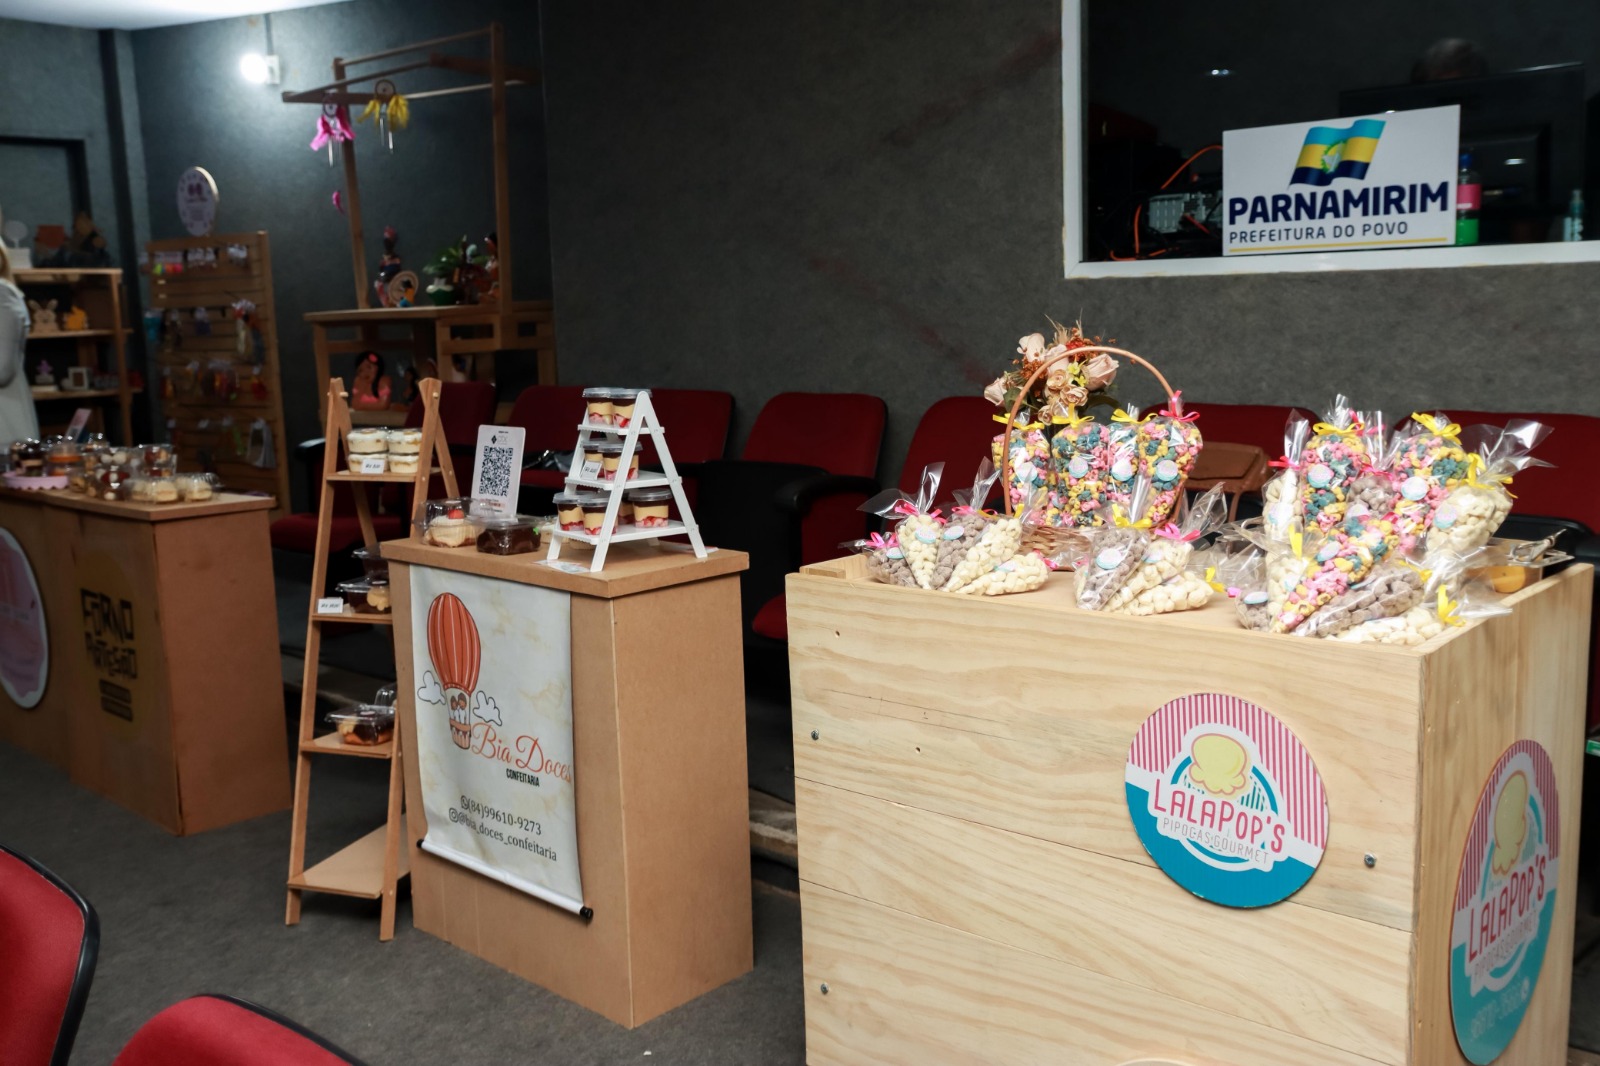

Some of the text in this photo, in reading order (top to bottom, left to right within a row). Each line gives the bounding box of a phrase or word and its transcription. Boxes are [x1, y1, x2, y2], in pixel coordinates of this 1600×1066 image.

[1228, 181, 1449, 226] PARNAMIRIM
[1229, 221, 1408, 244] PREFEITURA DO POVO
[471, 722, 573, 783] Bia Doces
[506, 768, 540, 787] CONFEITARIA
[1153, 778, 1285, 853] LALAPOP'S
[1163, 817, 1269, 865] PIPOCAS GOURMET
[1468, 853, 1546, 964] LALAPOP'S
